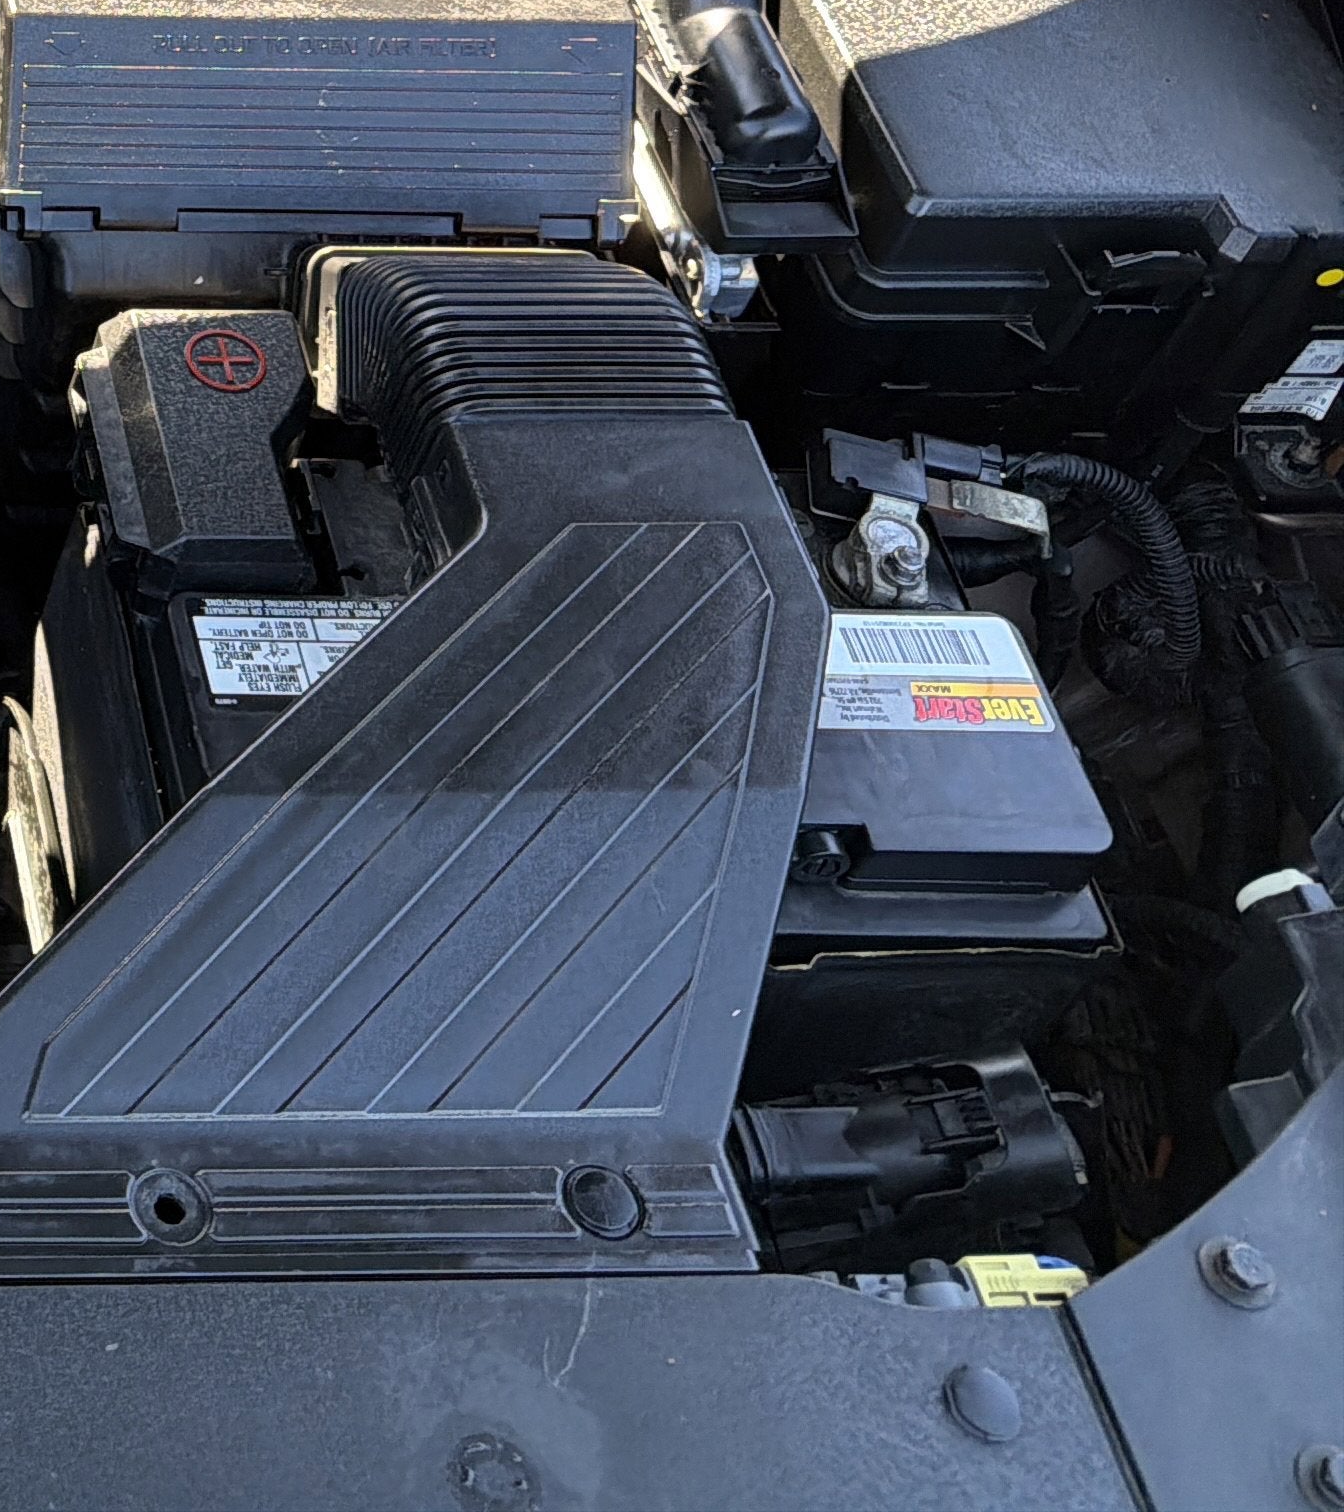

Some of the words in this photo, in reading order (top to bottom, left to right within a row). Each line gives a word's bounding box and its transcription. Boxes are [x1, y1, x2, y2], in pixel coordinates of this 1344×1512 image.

[152, 34, 209, 54] PULL
[214, 35, 259, 55] OUT
[262, 35, 292, 54] TO
[298, 35, 359, 55] OPEN
[274, 621, 291, 630] NOT
[294, 621, 306, 630] DO
[251, 629, 274, 638] OPEN
[277, 630, 294, 638] NOT
[296, 630, 308, 639] DO
[238, 642, 262, 651] HELP
[212, 651, 254, 661] MEDICAL
[238, 672, 298, 683] IMMEDIATELY
[248, 682, 271, 692] EYES
[273, 682, 302, 692] FLUSH
[915, 684, 951, 694] MAXX
[913, 696, 1046, 726] EverStart
